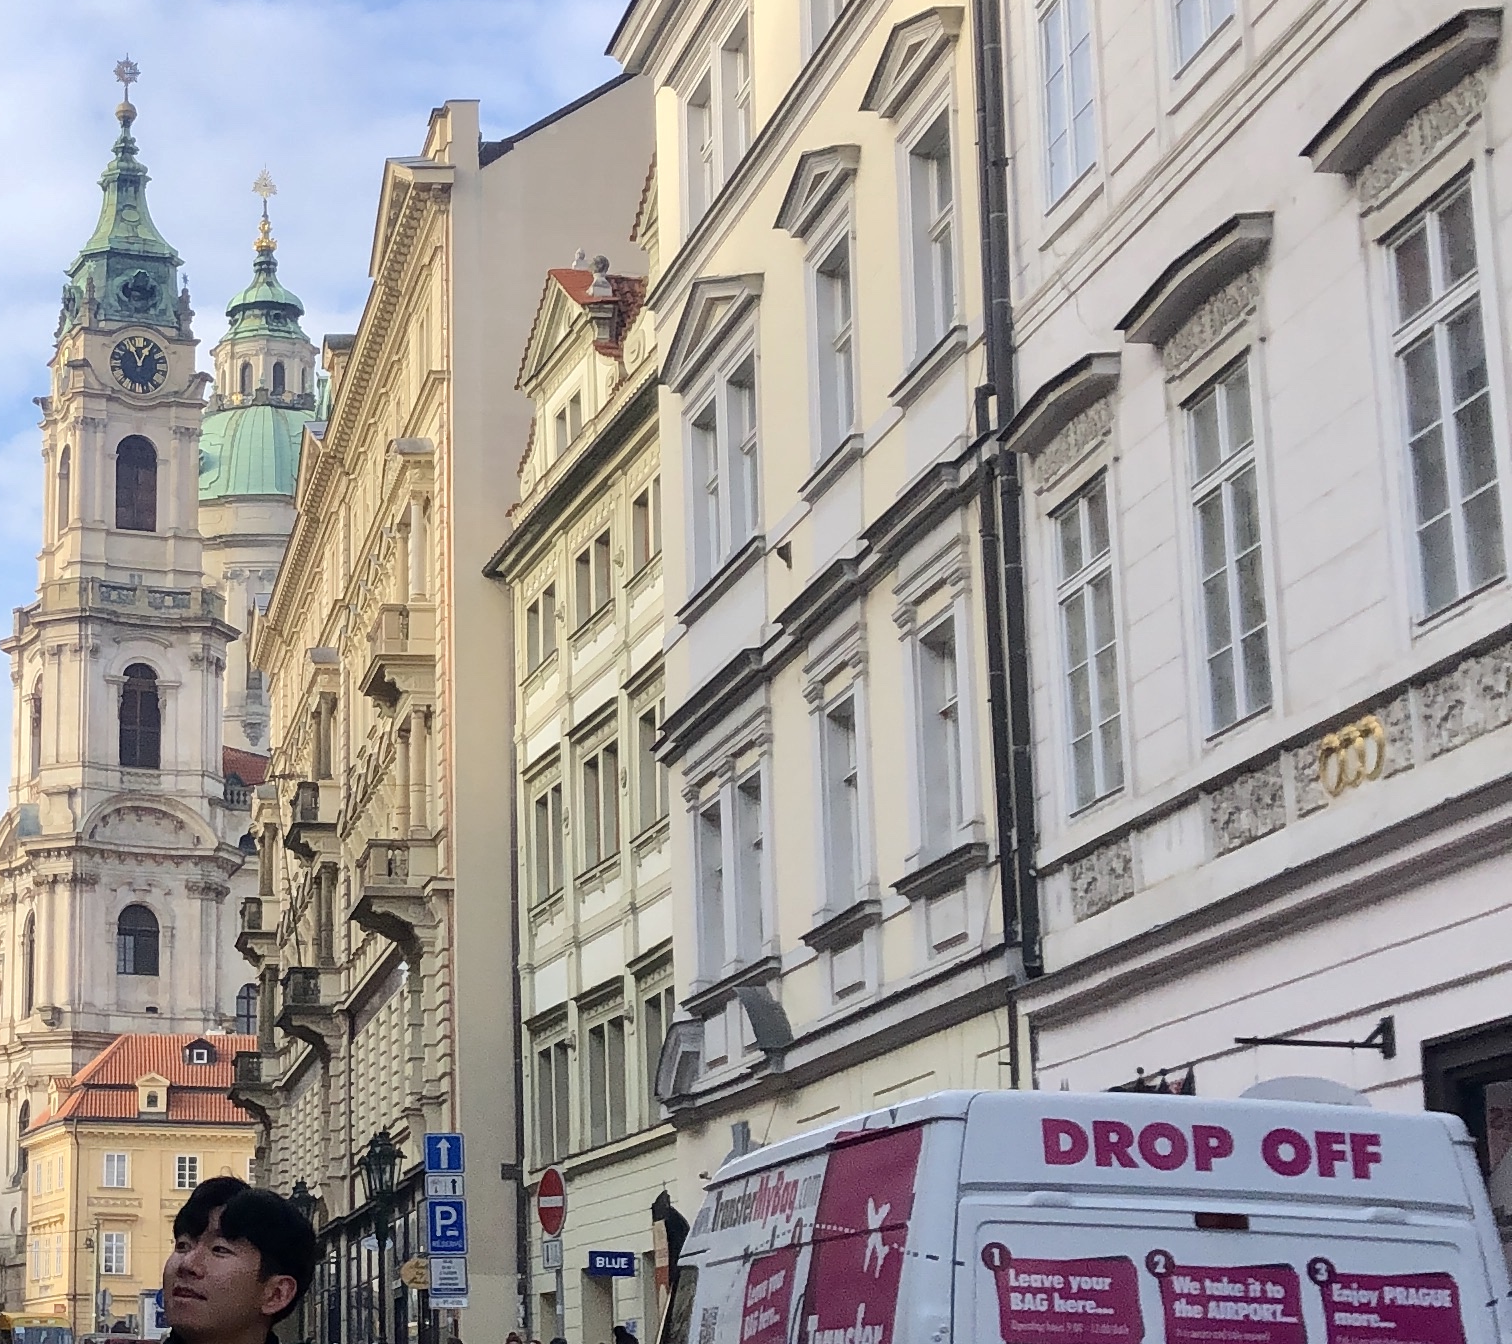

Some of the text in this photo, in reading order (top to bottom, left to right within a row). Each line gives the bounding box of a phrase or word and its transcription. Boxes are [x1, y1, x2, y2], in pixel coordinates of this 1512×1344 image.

[1041, 1118, 1382, 1180] DROP OFF
[435, 1206, 458, 1237] P
[595, 1257, 629, 1268] BLUE
[991, 1249, 1001, 1266] 1
[1155, 1255, 1166, 1273] 2
[1009, 1268, 1112, 1292] Leave your
[1314, 1262, 1329, 1281] 3
[1173, 1275, 1286, 1299] We take it to
[1331, 1282, 1453, 1308] Enjoy PRAGUE
[1010, 1292, 1048, 1312] BAG
[1174, 1300, 1204, 1319] the
